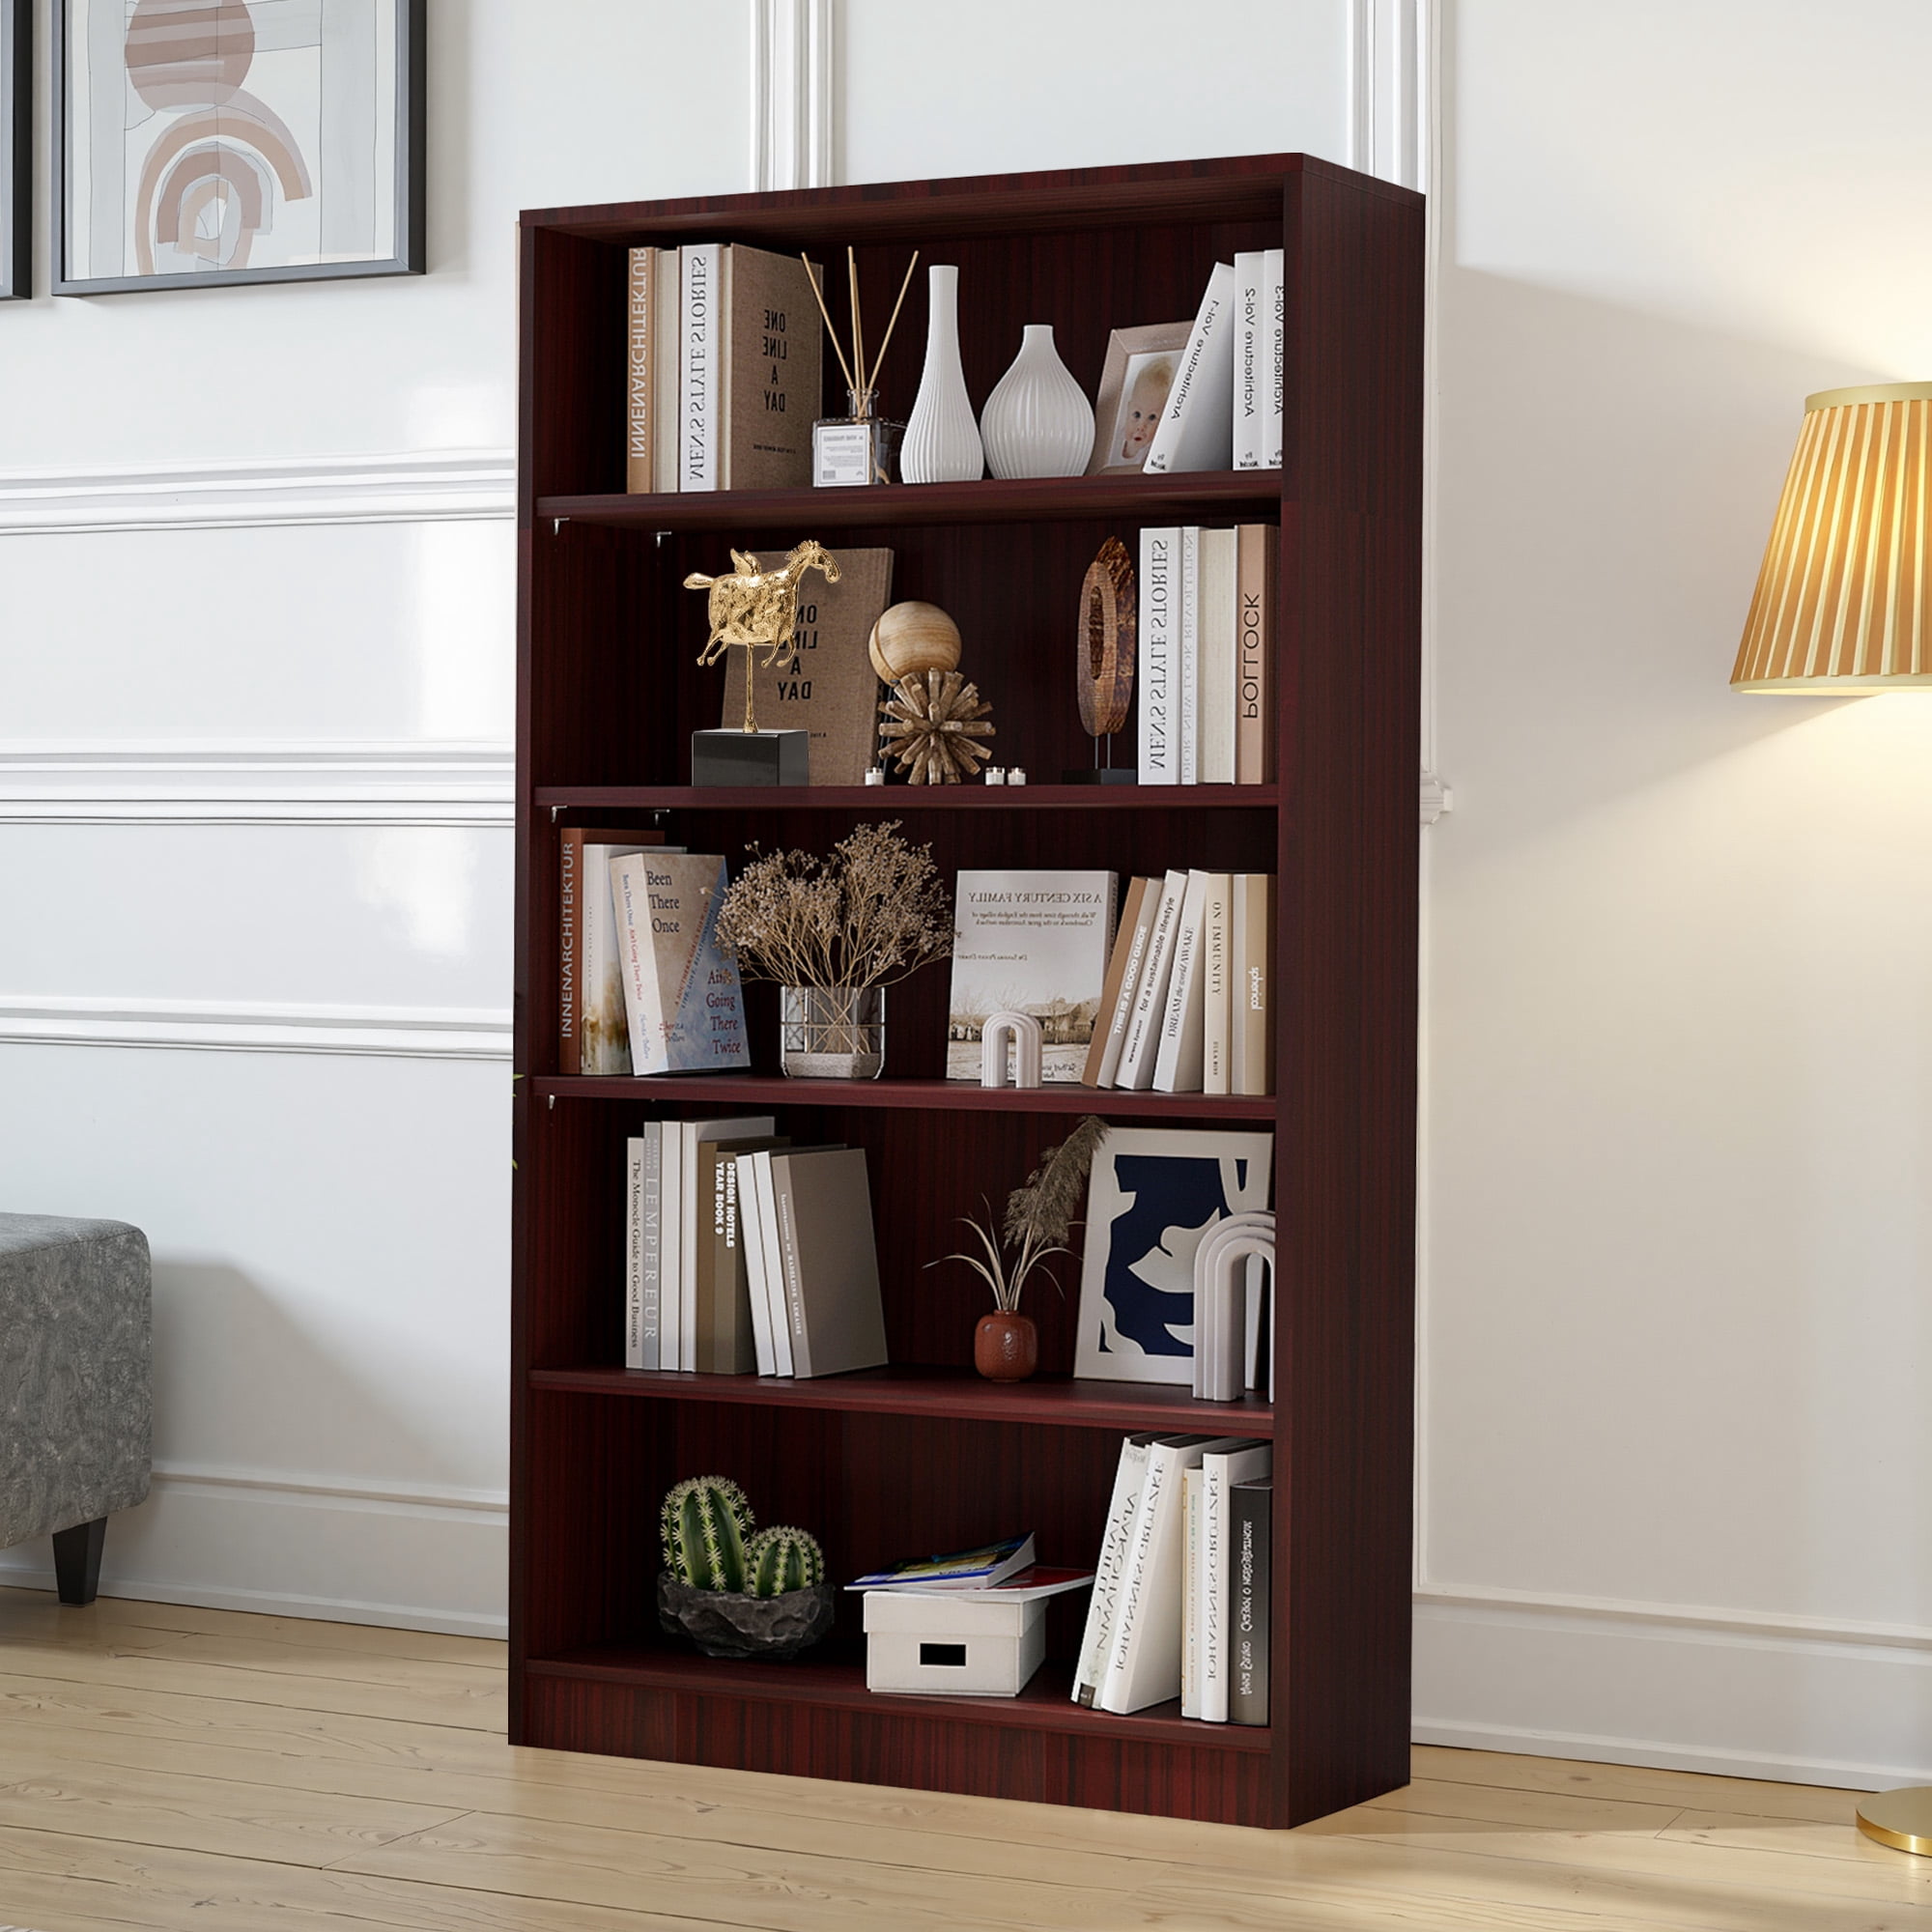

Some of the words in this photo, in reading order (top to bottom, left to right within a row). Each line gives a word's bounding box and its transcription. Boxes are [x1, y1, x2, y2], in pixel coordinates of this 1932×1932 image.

[646, 870, 672, 886] Been
[648, 894, 680, 909] There
[1212, 901, 1221, 919] ON
[561, 842, 575, 1037] INNENARCHITEKTUR
[651, 918, 680, 933] Once
[1132, 924, 1148, 958] GUIDE
[1139, 997, 1151, 1012] for
[1145, 934, 1166, 988] sustainable
[1158, 895, 1178, 934] lifestyle
[1211, 925, 1221, 996] IMMUNITY
[1124, 958, 1140, 990] GOOD
[1165, 998, 1184, 1038] DREAM
[1177, 925, 1197, 965] AWAKE
[1248, 966, 1264, 1010] spherical
[706, 993, 735, 1011] Going
[1119, 1001, 1129, 1011] IS
[1122, 990, 1132, 1000] A
[710, 1016, 739, 1031] There
[1113, 1010, 1126, 1036] THIS
[712, 1038, 741, 1054] Twice
[633, 1159, 641, 1181] The
[715, 1161, 724, 1192] YEAR
[726, 1162, 735, 1204] DESIGN
[633, 1182, 641, 1227] Monocle
[715, 1193, 724, 1225] BOOK
[726, 1206, 735, 1248] HOTELS
[632, 1229, 641, 1260] Guide
[644, 1177, 658, 1339] LEMPEREUR
[633, 1262, 640, 1272] to
[632, 1274, 641, 1302] Good
[631, 1305, 640, 1349] Business
